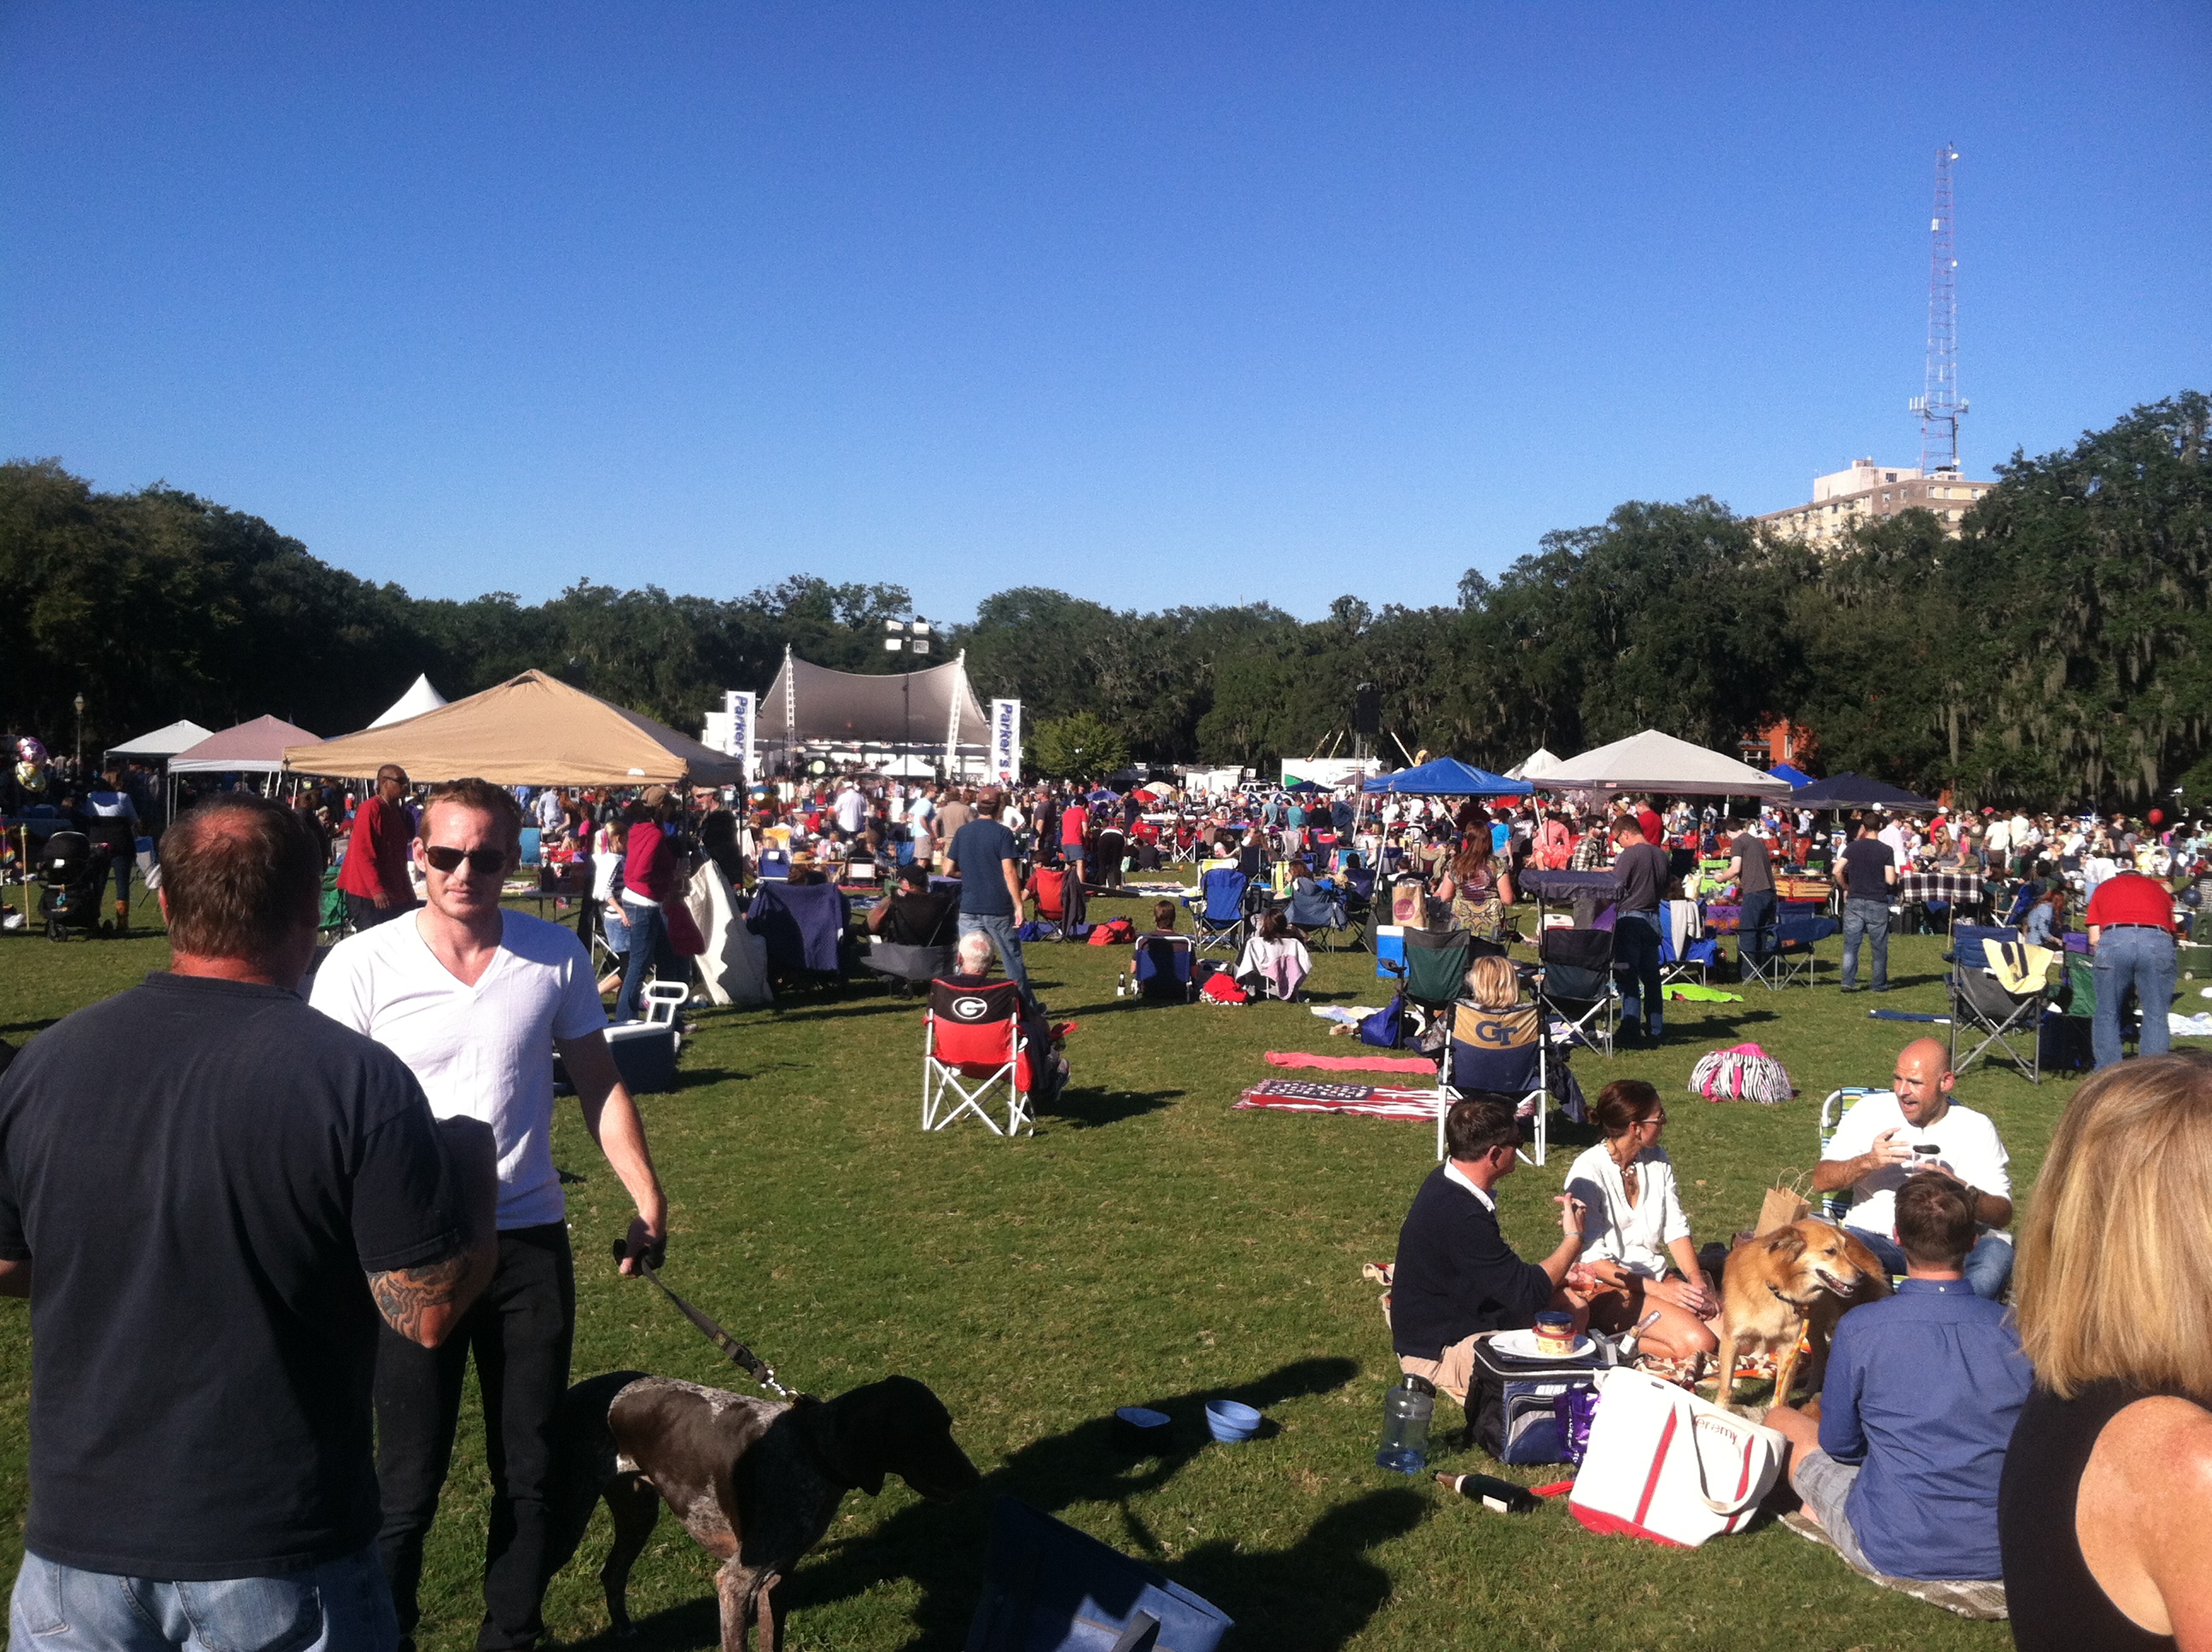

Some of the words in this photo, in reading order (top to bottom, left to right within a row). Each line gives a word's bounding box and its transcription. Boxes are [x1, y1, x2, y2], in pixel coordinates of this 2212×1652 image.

[999, 703, 1013, 768] Parker's
[957, 999, 987, 1016] G
[1476, 1021, 1518, 1046] GT
